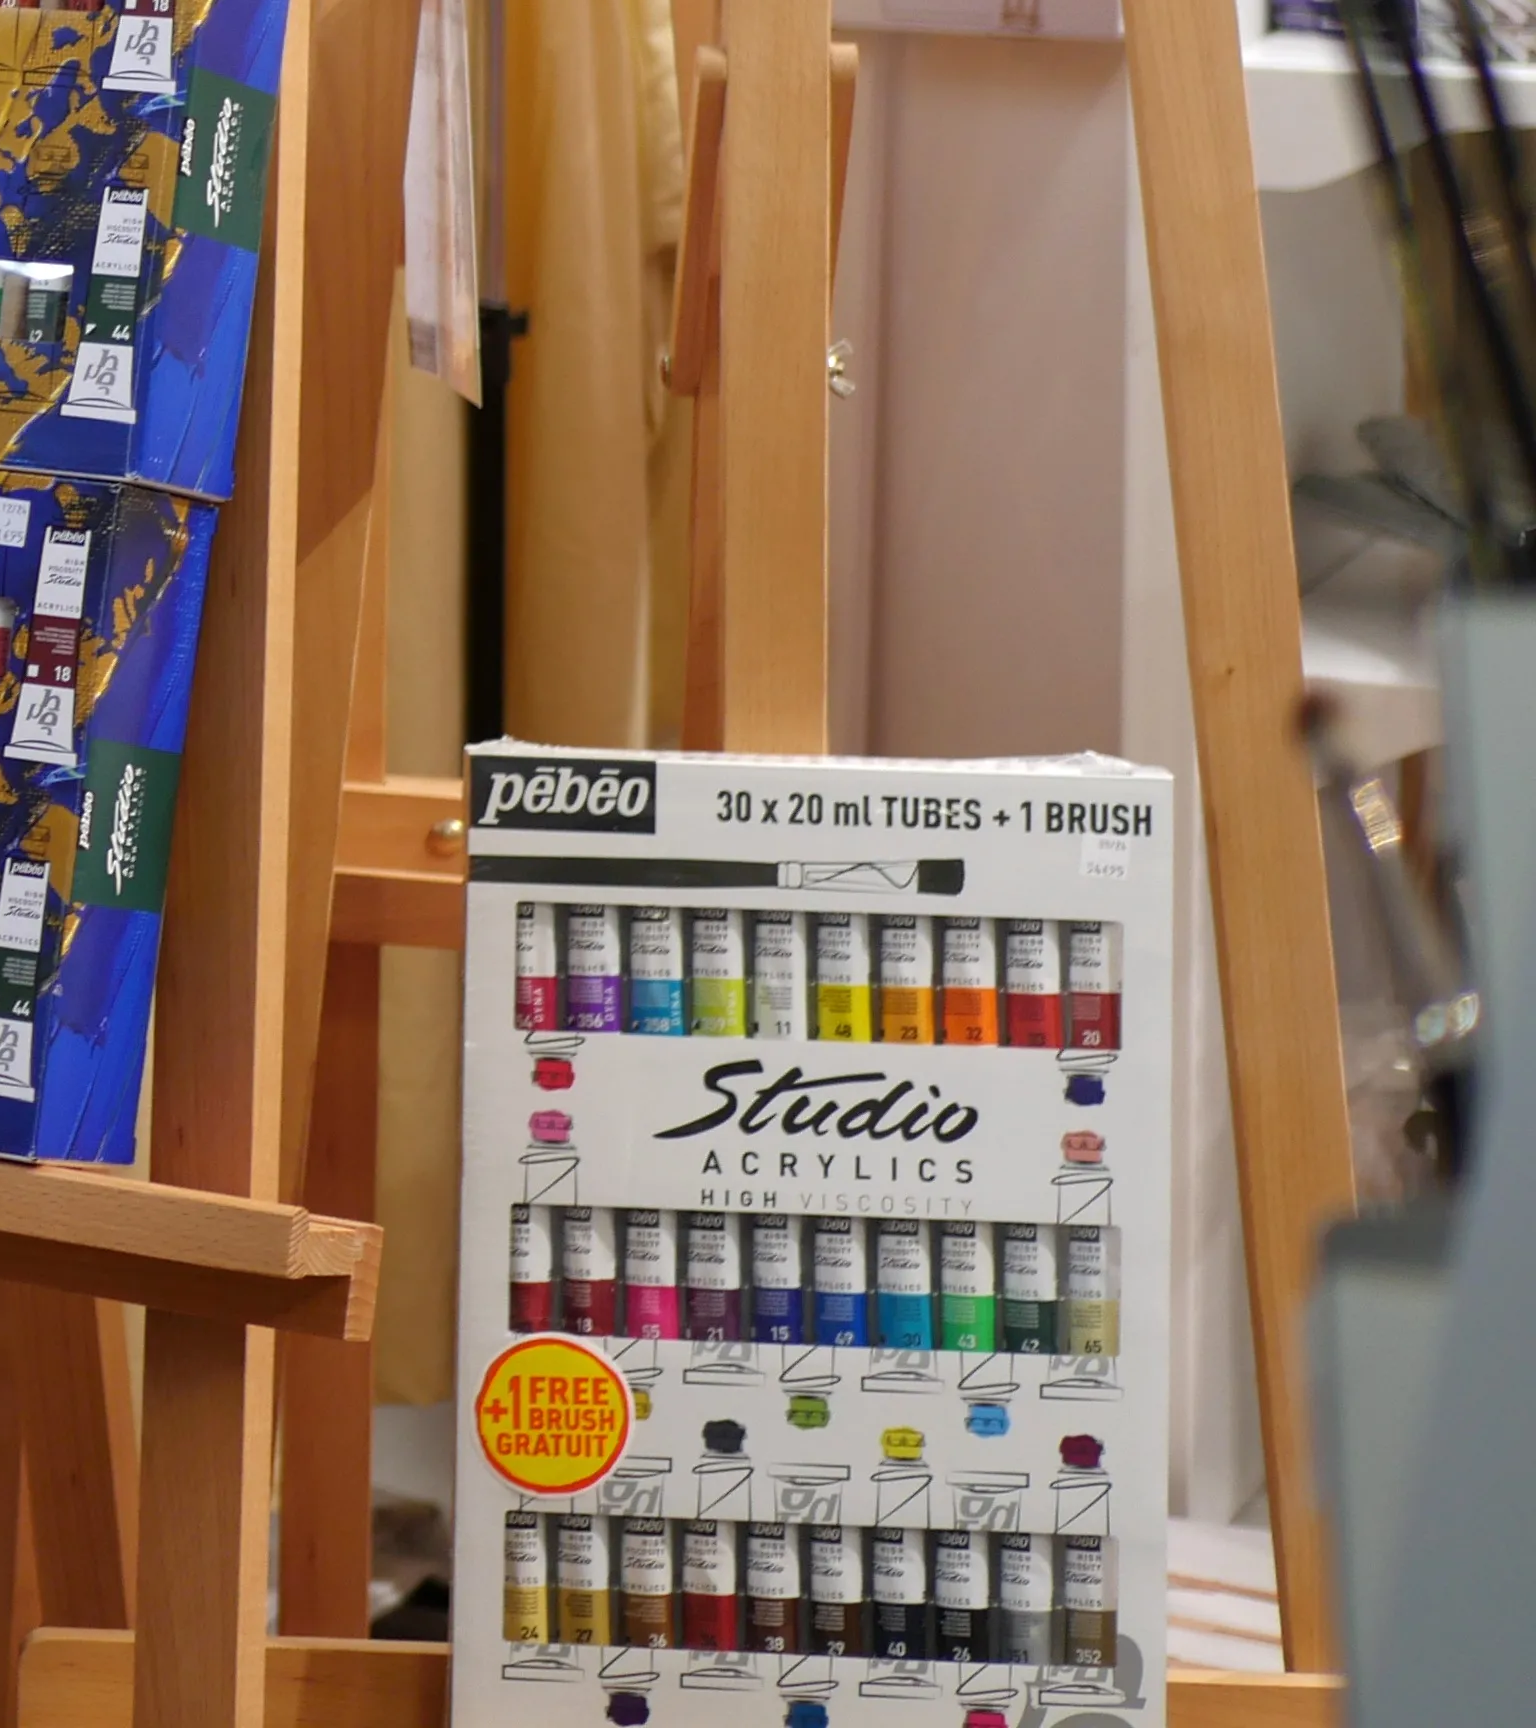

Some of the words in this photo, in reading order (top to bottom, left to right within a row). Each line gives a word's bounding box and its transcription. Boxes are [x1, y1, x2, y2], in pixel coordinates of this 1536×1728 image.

[204, 97, 233, 228] Studio
[95, 261, 139, 272] ACRYLICS
[111, 325, 131, 342] 44
[44, 574, 82, 587] Studio
[37, 602, 80, 613] ACRYLICS
[53, 666, 71, 682] 18
[716, 790, 751, 822] 30
[788, 794, 823, 825] 20
[834, 795, 872, 826] ml
[882, 797, 981, 830] TUBES
[1020, 802, 1033, 833] 1
[1046, 802, 1153, 837] BRUSH
[105, 763, 132, 896] Studio
[3, 905, 41, 920] Studio
[12, 1001, 30, 1016] 44
[776, 1022, 792, 1034] 11
[1082, 1030, 1101, 1046] 20
[653, 1058, 980, 1144] Studio
[702, 1150, 974, 1184] ACRYLICS
[700, 1189, 778, 1207] HIGH
[800, 1192, 973, 1216] VISCOSITY
[576, 1318, 592, 1332] 18
[642, 1325, 660, 1338] 55
[707, 1328, 724, 1340] 21
[771, 1326, 789, 1340] 15
[1021, 1339, 1039, 1353] 42
[1084, 1339, 1102, 1354] 65
[485, 1375, 522, 1430] +1
[528, 1377, 609, 1406] FREE
[529, 1409, 615, 1432] BRUSH
[497, 1434, 609, 1458] GRATUIT
[521, 1626, 539, 1640] 24
[649, 1634, 667, 1648] 36
[766, 1636, 784, 1651] 38
[827, 1641, 845, 1656] 29
[888, 1641, 905, 1657] 40
[952, 1647, 971, 1662] 26
[1076, 1649, 1102, 1664] 352
